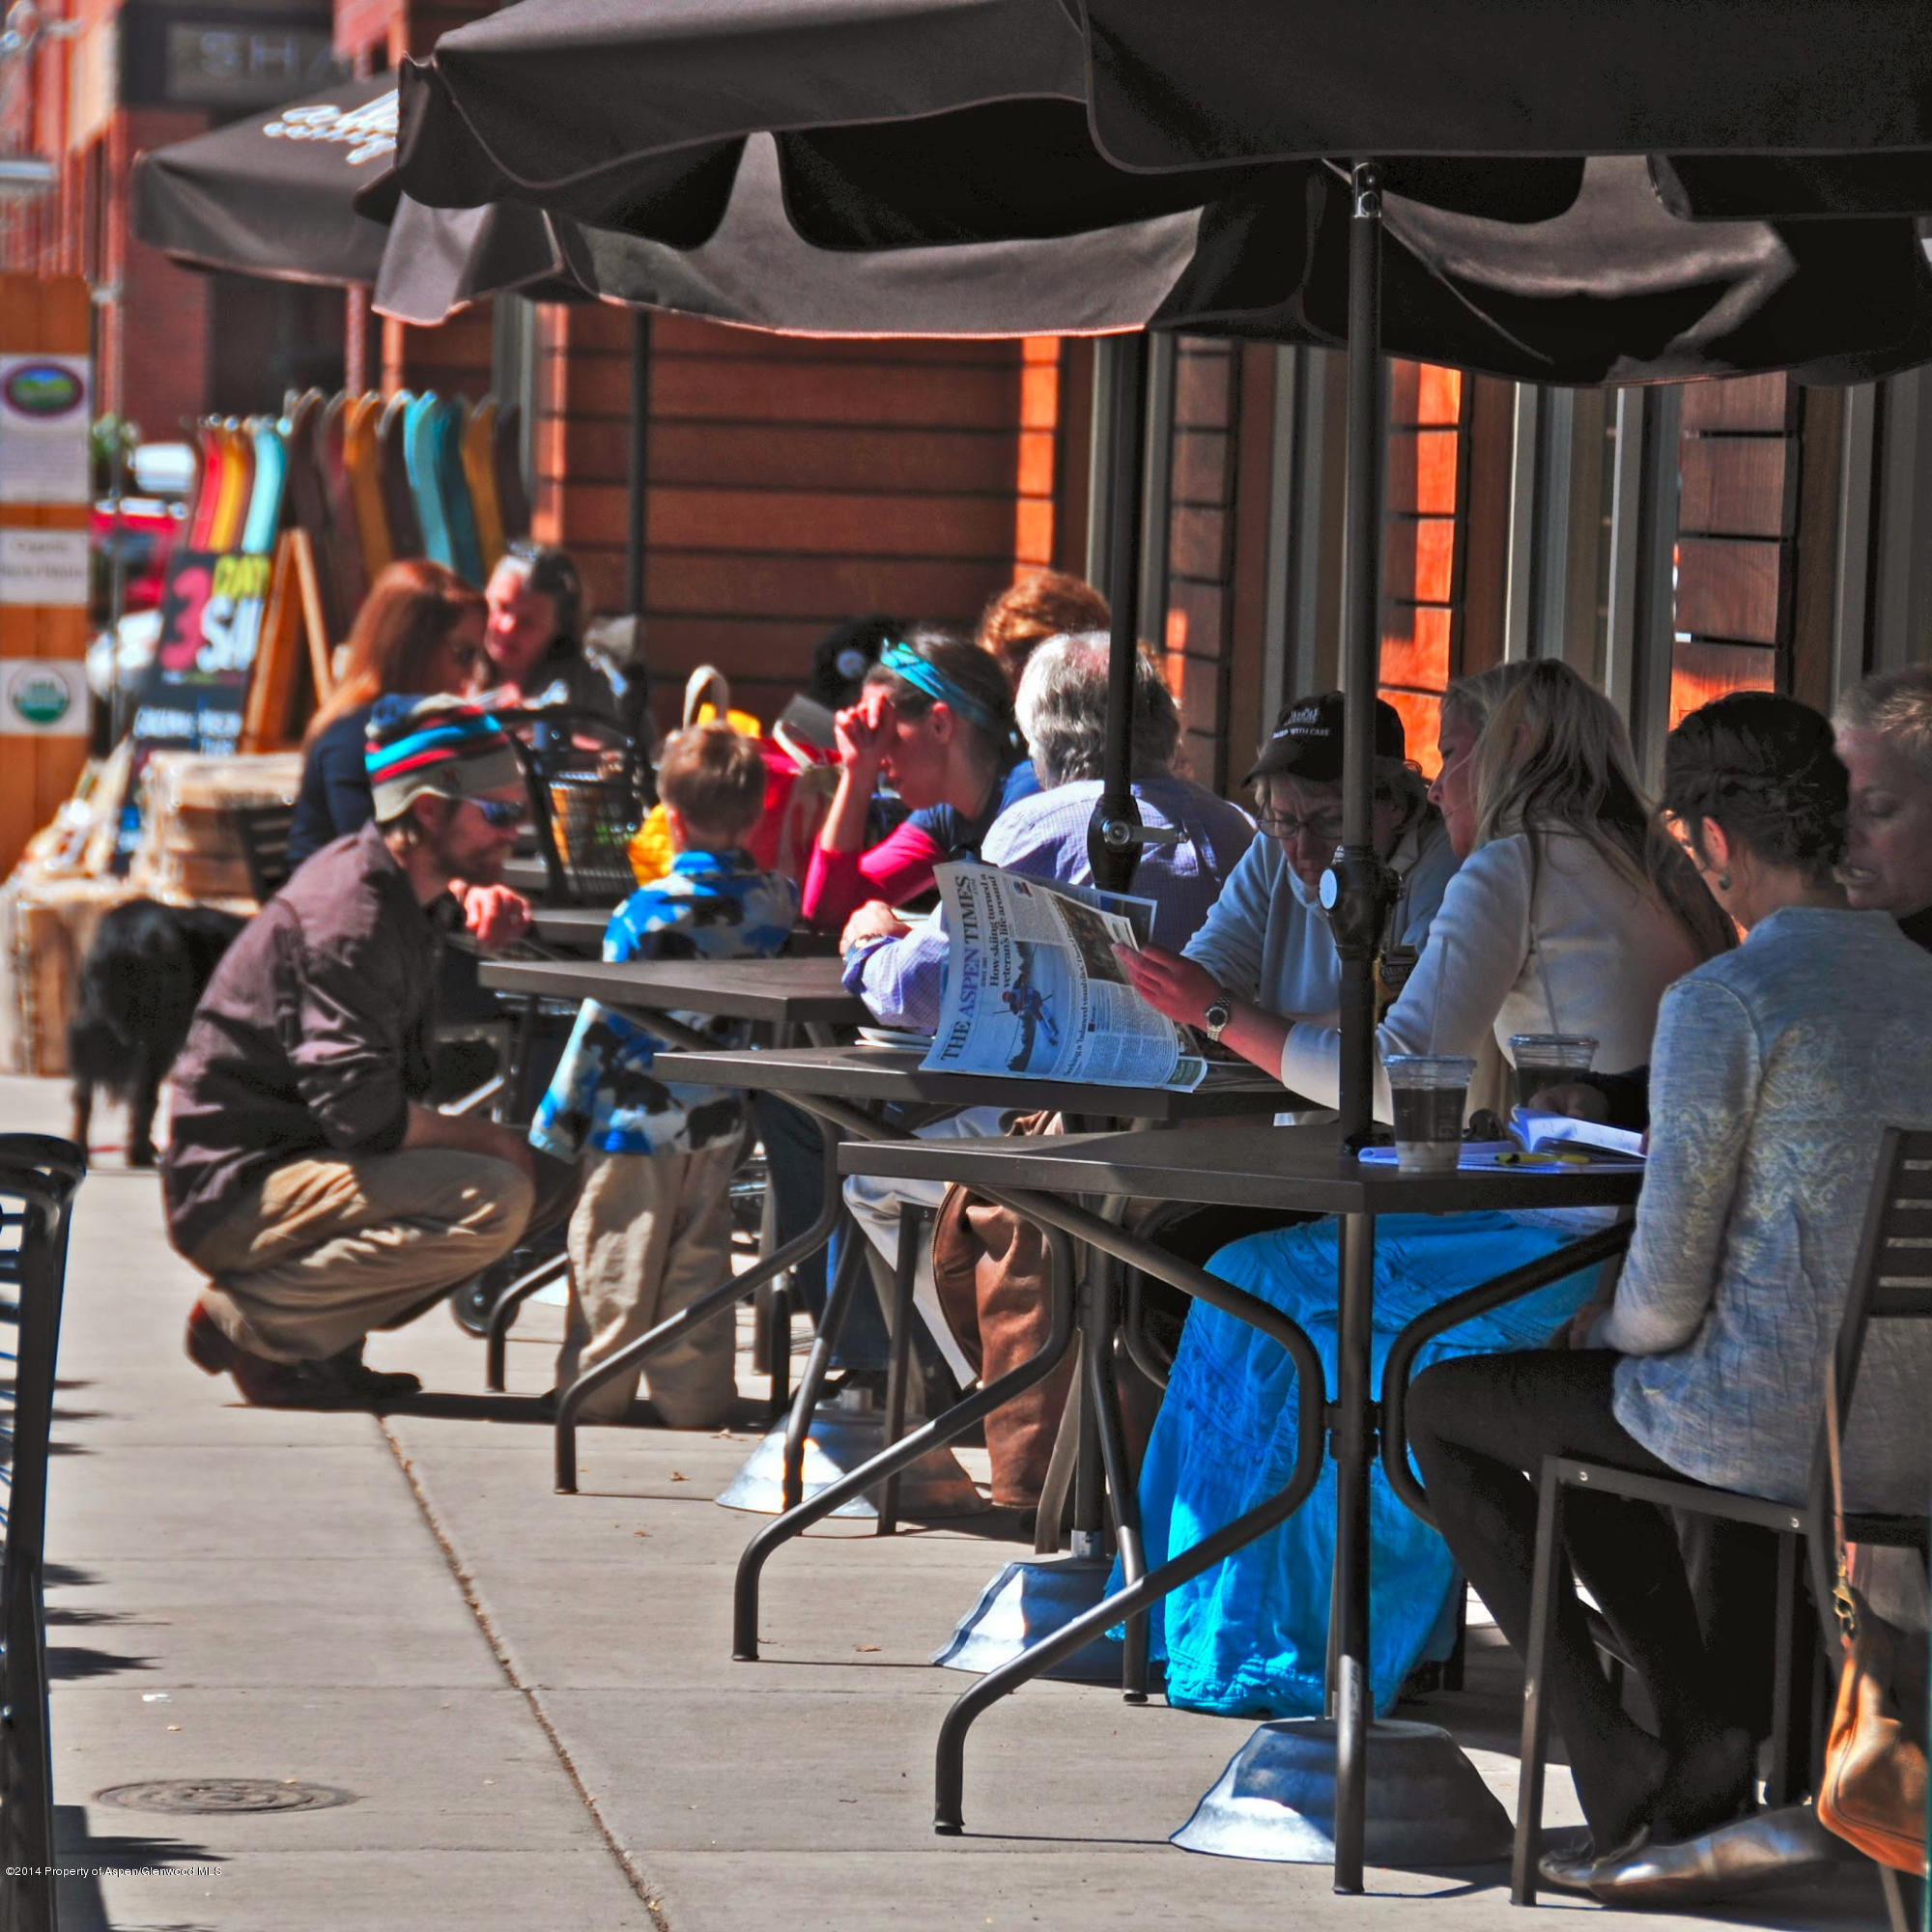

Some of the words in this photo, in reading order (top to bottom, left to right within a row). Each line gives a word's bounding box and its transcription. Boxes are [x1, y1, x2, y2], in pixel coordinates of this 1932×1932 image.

[161, 568, 210, 668] 3
[1310, 727, 1330, 736] CARE
[955, 875, 979, 944] TIMES
[980, 882, 995, 920] turned
[988, 876, 1006, 916] around
[988, 921, 999, 956] skiing
[998, 918, 1009, 936] life
[989, 957, 1000, 986] How
[1001, 937, 1011, 987] veteran's
[958, 948, 980, 1017] ASPEN
[940, 1020, 971, 1061] THE
